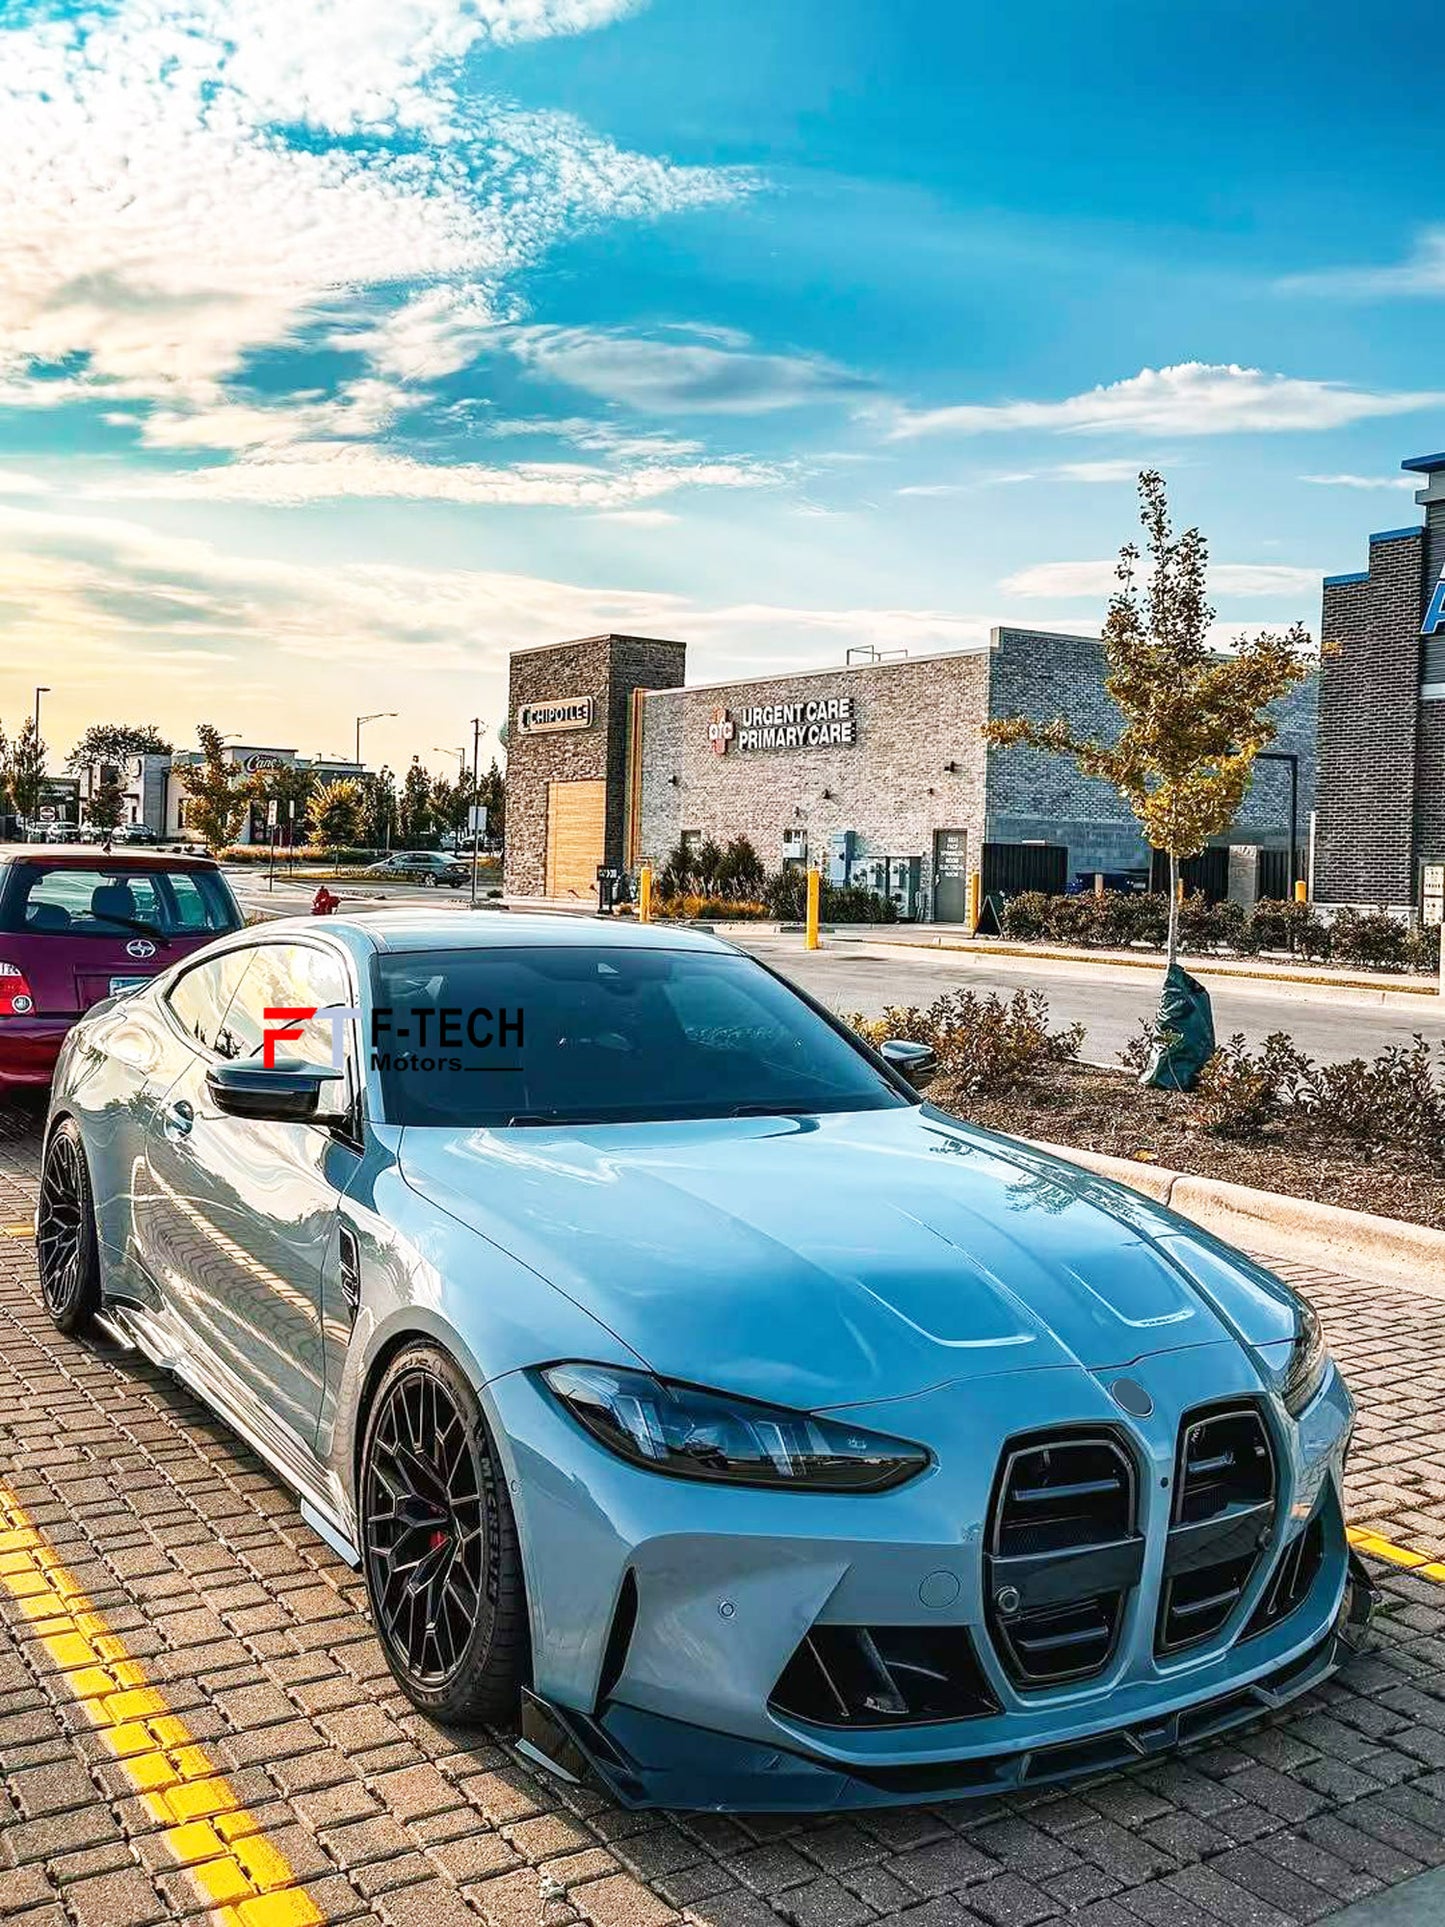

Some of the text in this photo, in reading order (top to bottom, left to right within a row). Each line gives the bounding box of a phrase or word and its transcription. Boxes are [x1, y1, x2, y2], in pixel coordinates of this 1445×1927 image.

[531, 704, 587, 724] CHIPOTLE
[742, 698, 851, 727] URGENT CARE
[738, 721, 852, 750] PRIMARY CARE
